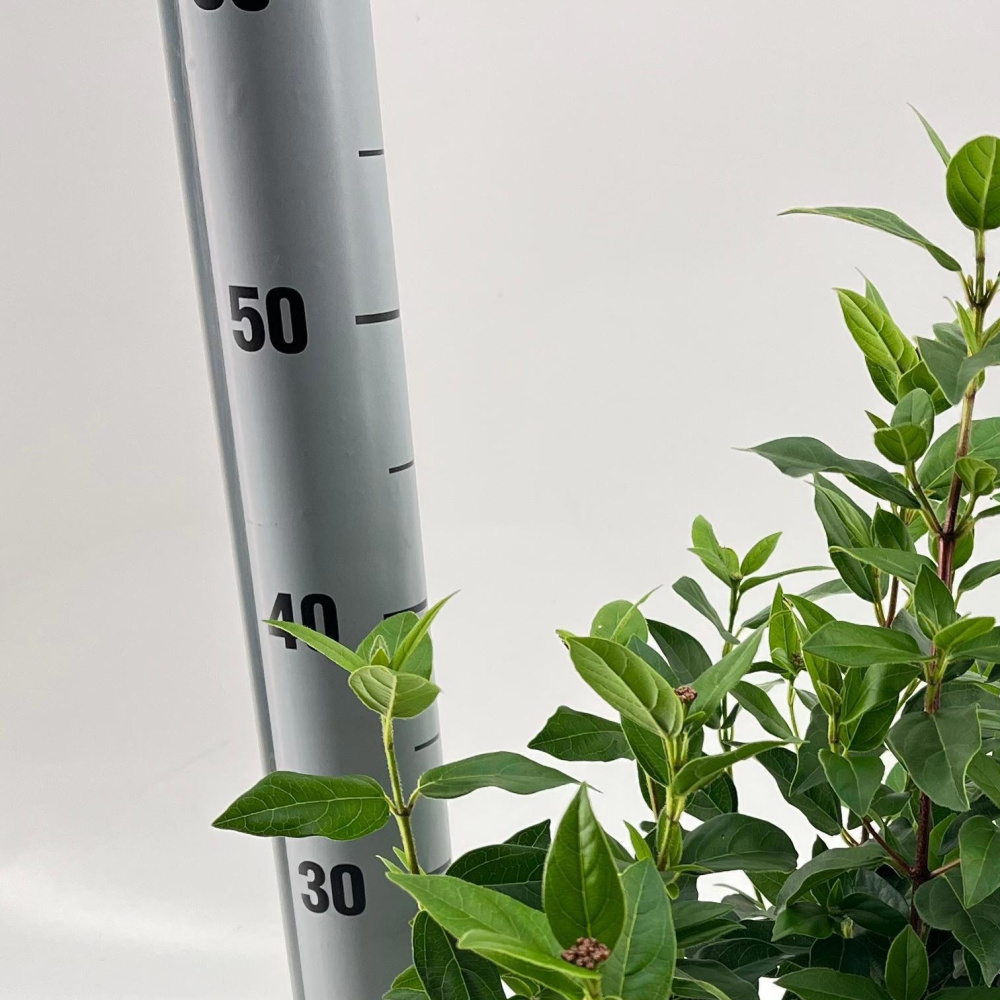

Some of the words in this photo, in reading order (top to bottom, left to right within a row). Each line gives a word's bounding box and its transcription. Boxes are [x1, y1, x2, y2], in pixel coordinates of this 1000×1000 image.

[228, 285, 308, 355] 50
[267, 592, 340, 651] 40
[299, 861, 365, 917] 30
